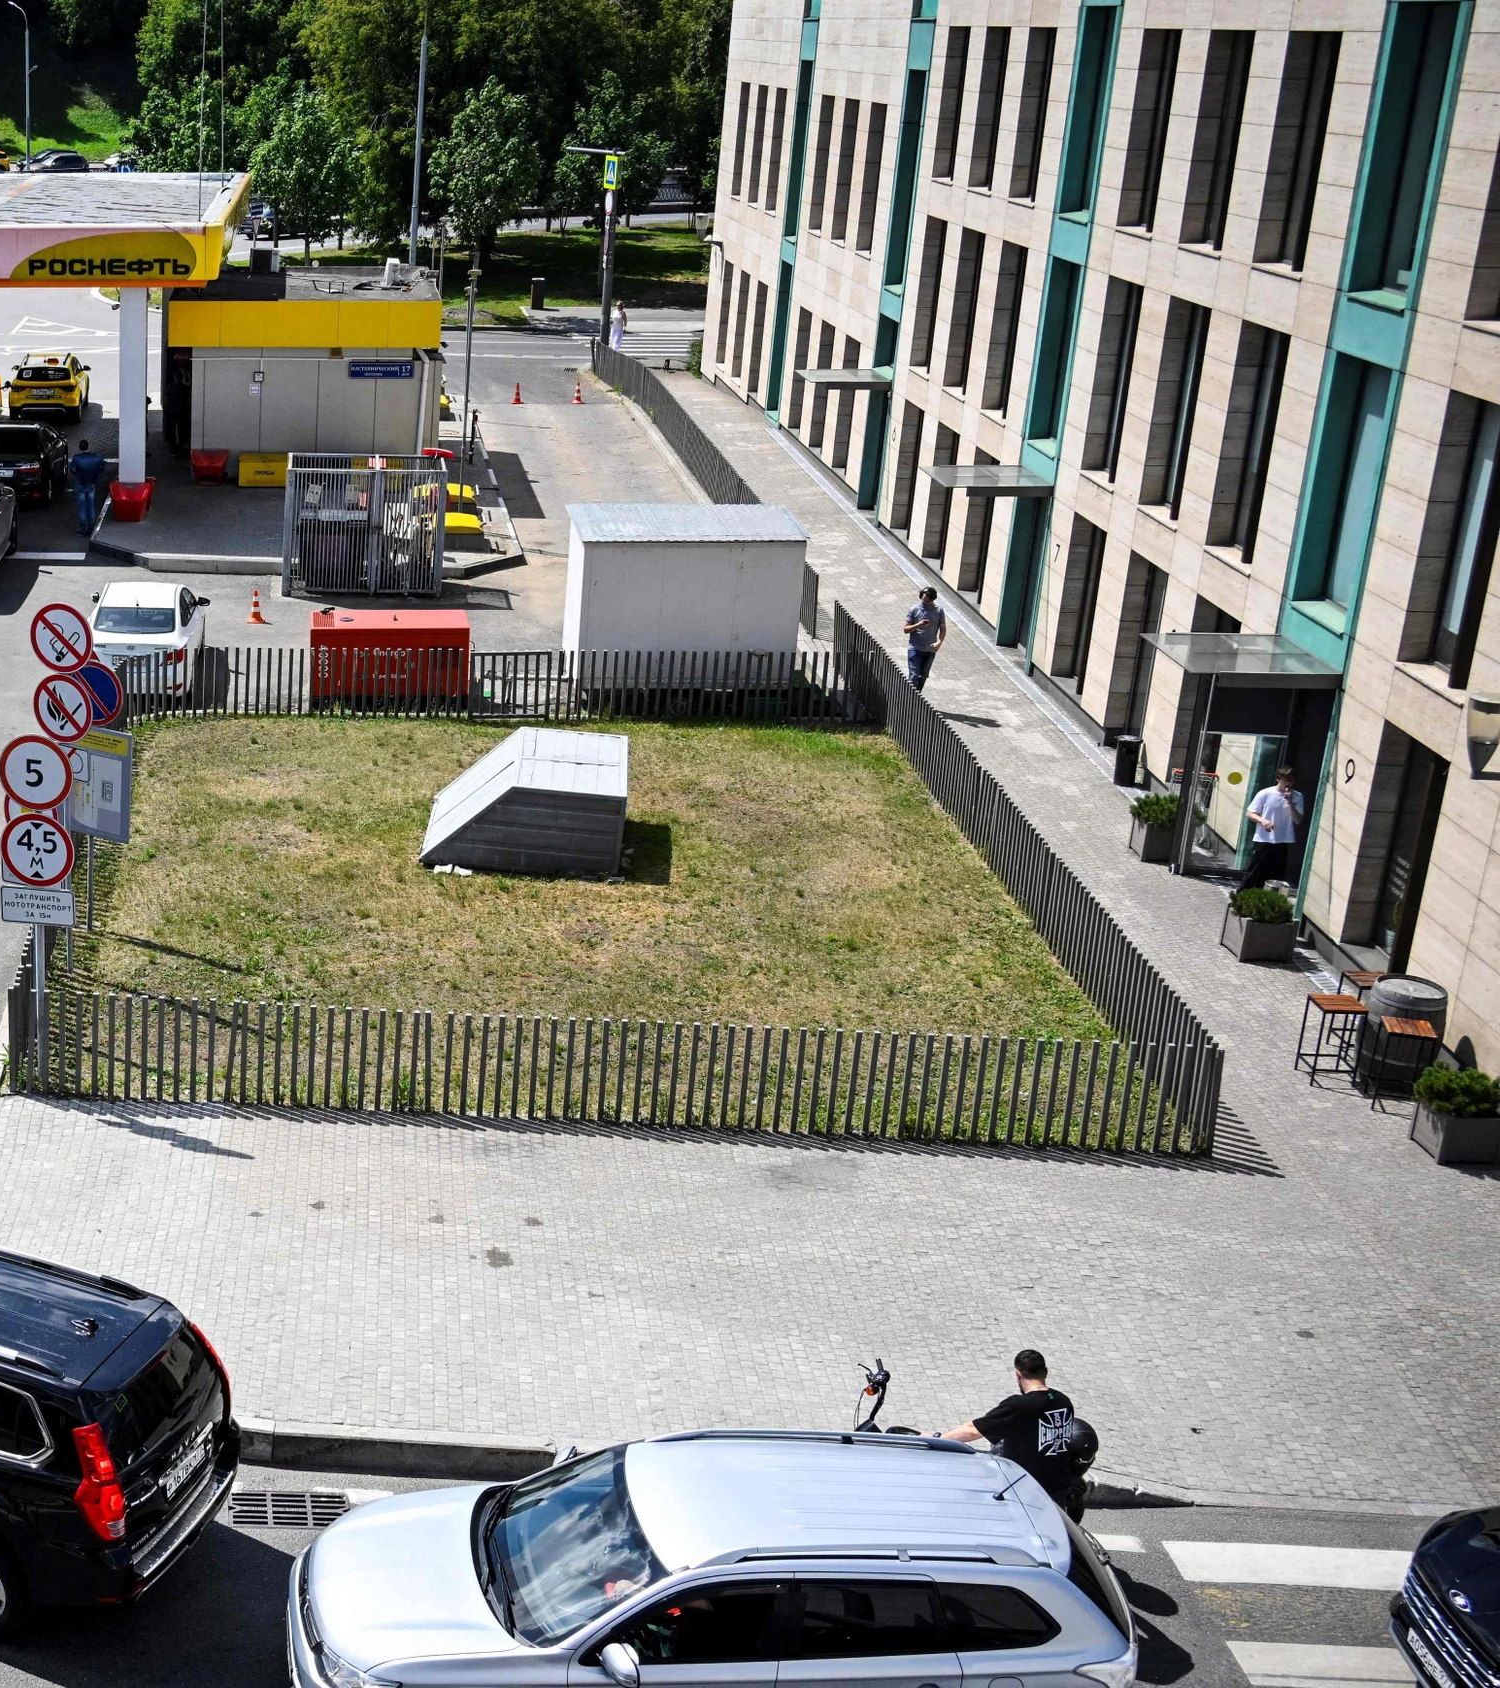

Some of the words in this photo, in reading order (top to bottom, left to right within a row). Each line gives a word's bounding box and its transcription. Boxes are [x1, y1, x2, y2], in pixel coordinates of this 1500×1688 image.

[28, 258, 191, 276] РОСНЕФТЬ
[25, 758, 44, 787] 5
[16, 828, 57, 856] 4,5
[29, 856, 44, 870] М
[14, 892, 61, 902] ЗАГЛУШИТЬ
[4, 901, 72, 912] МОТОТРАНСПОРТ
